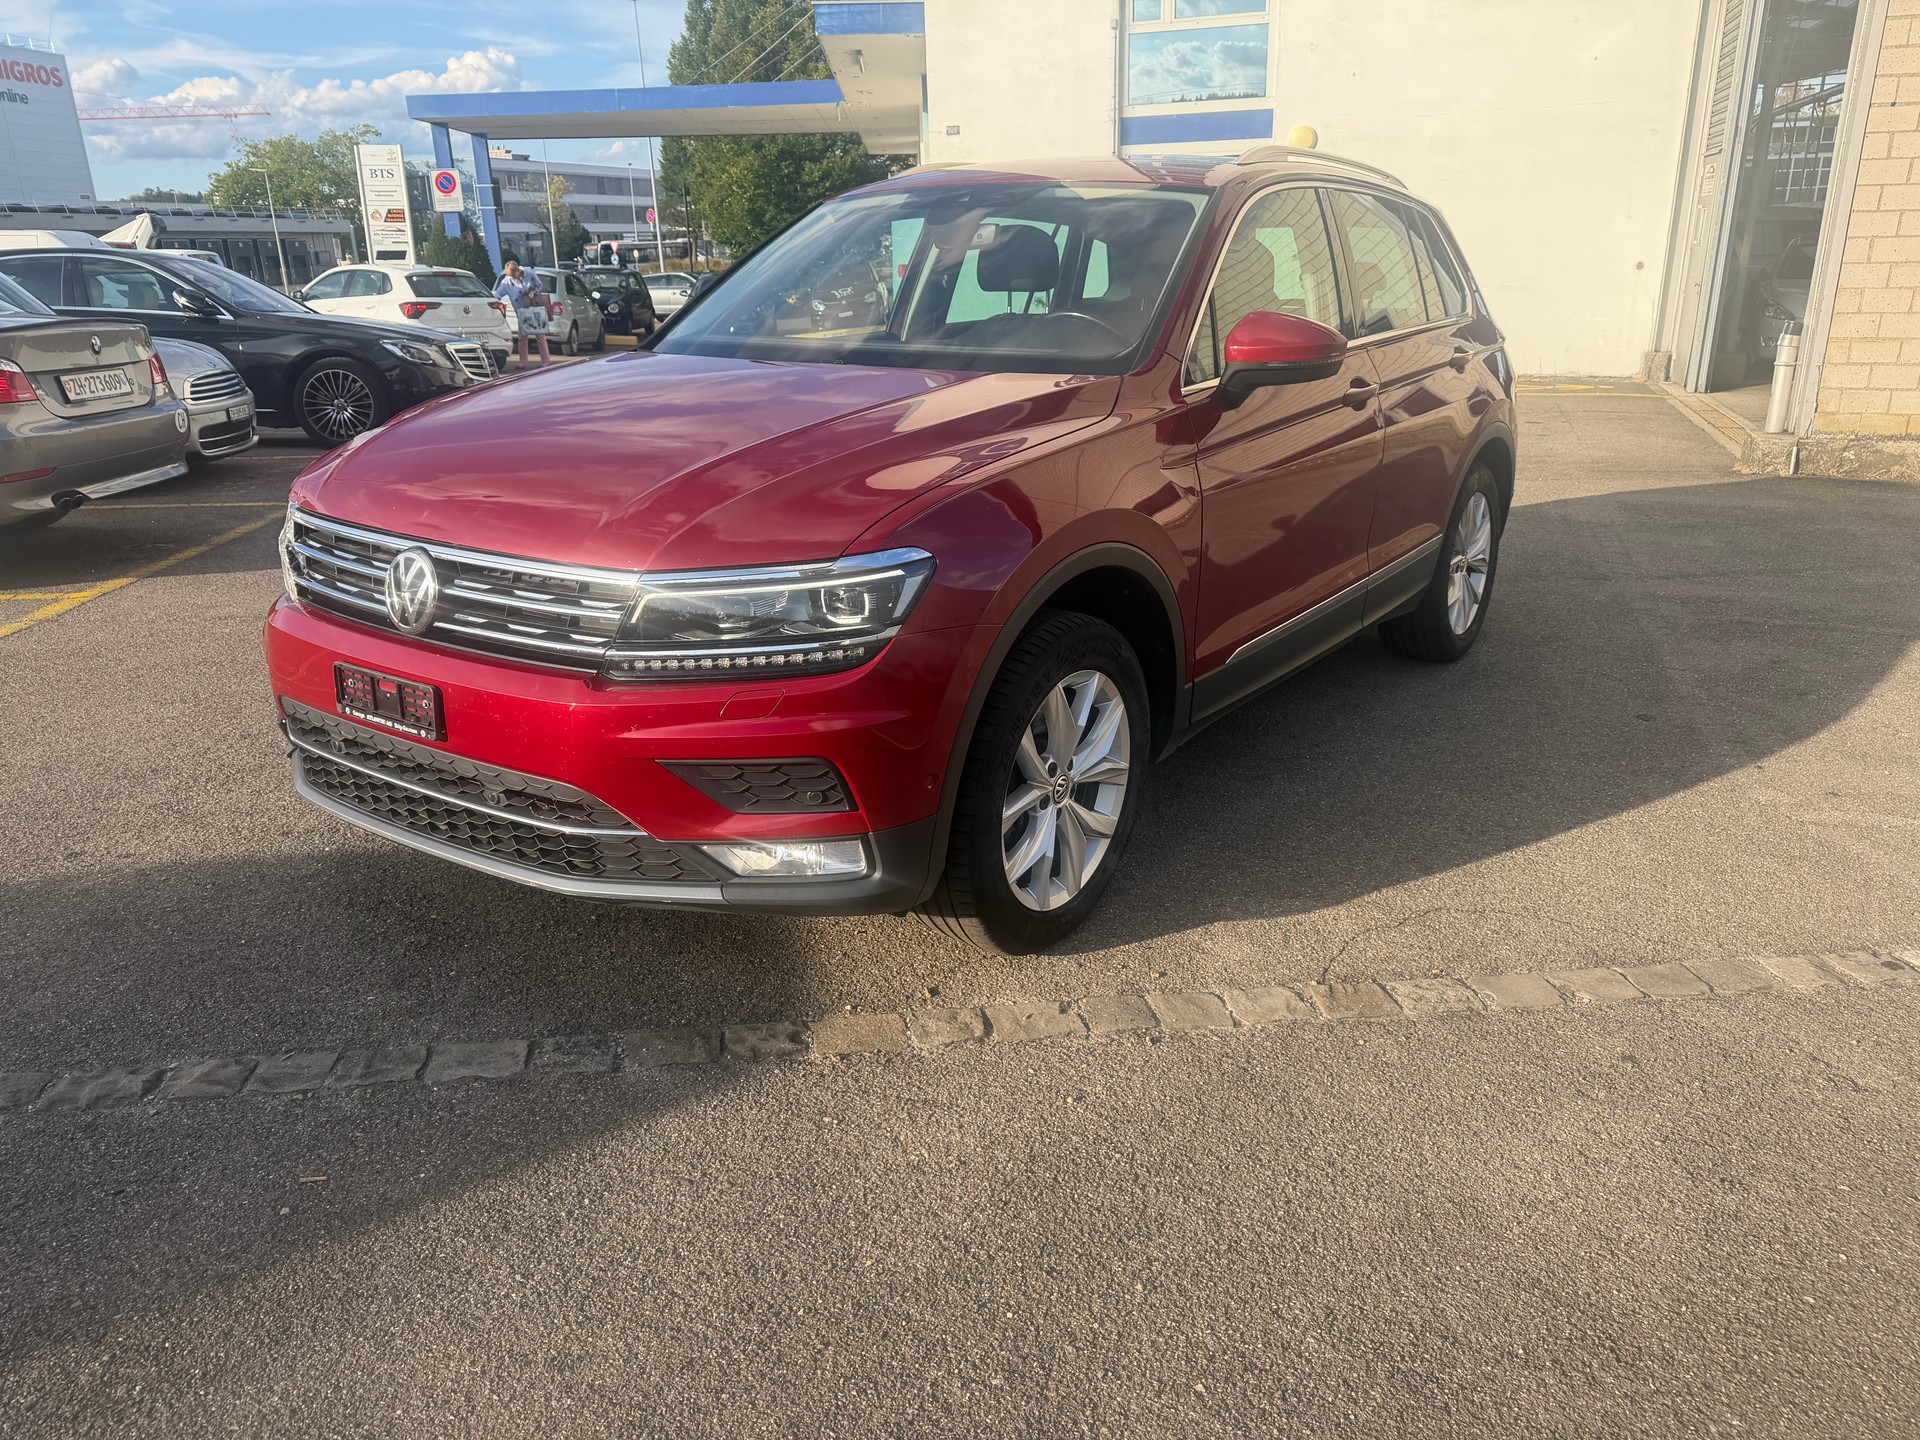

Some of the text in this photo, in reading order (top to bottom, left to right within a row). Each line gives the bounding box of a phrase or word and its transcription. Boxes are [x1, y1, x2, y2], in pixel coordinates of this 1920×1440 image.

[0, 88, 29, 104] nline
[369, 168, 394, 179] BTS
[177, 410, 186, 430] CH
[366, 714, 386, 725] ATLANTIC
